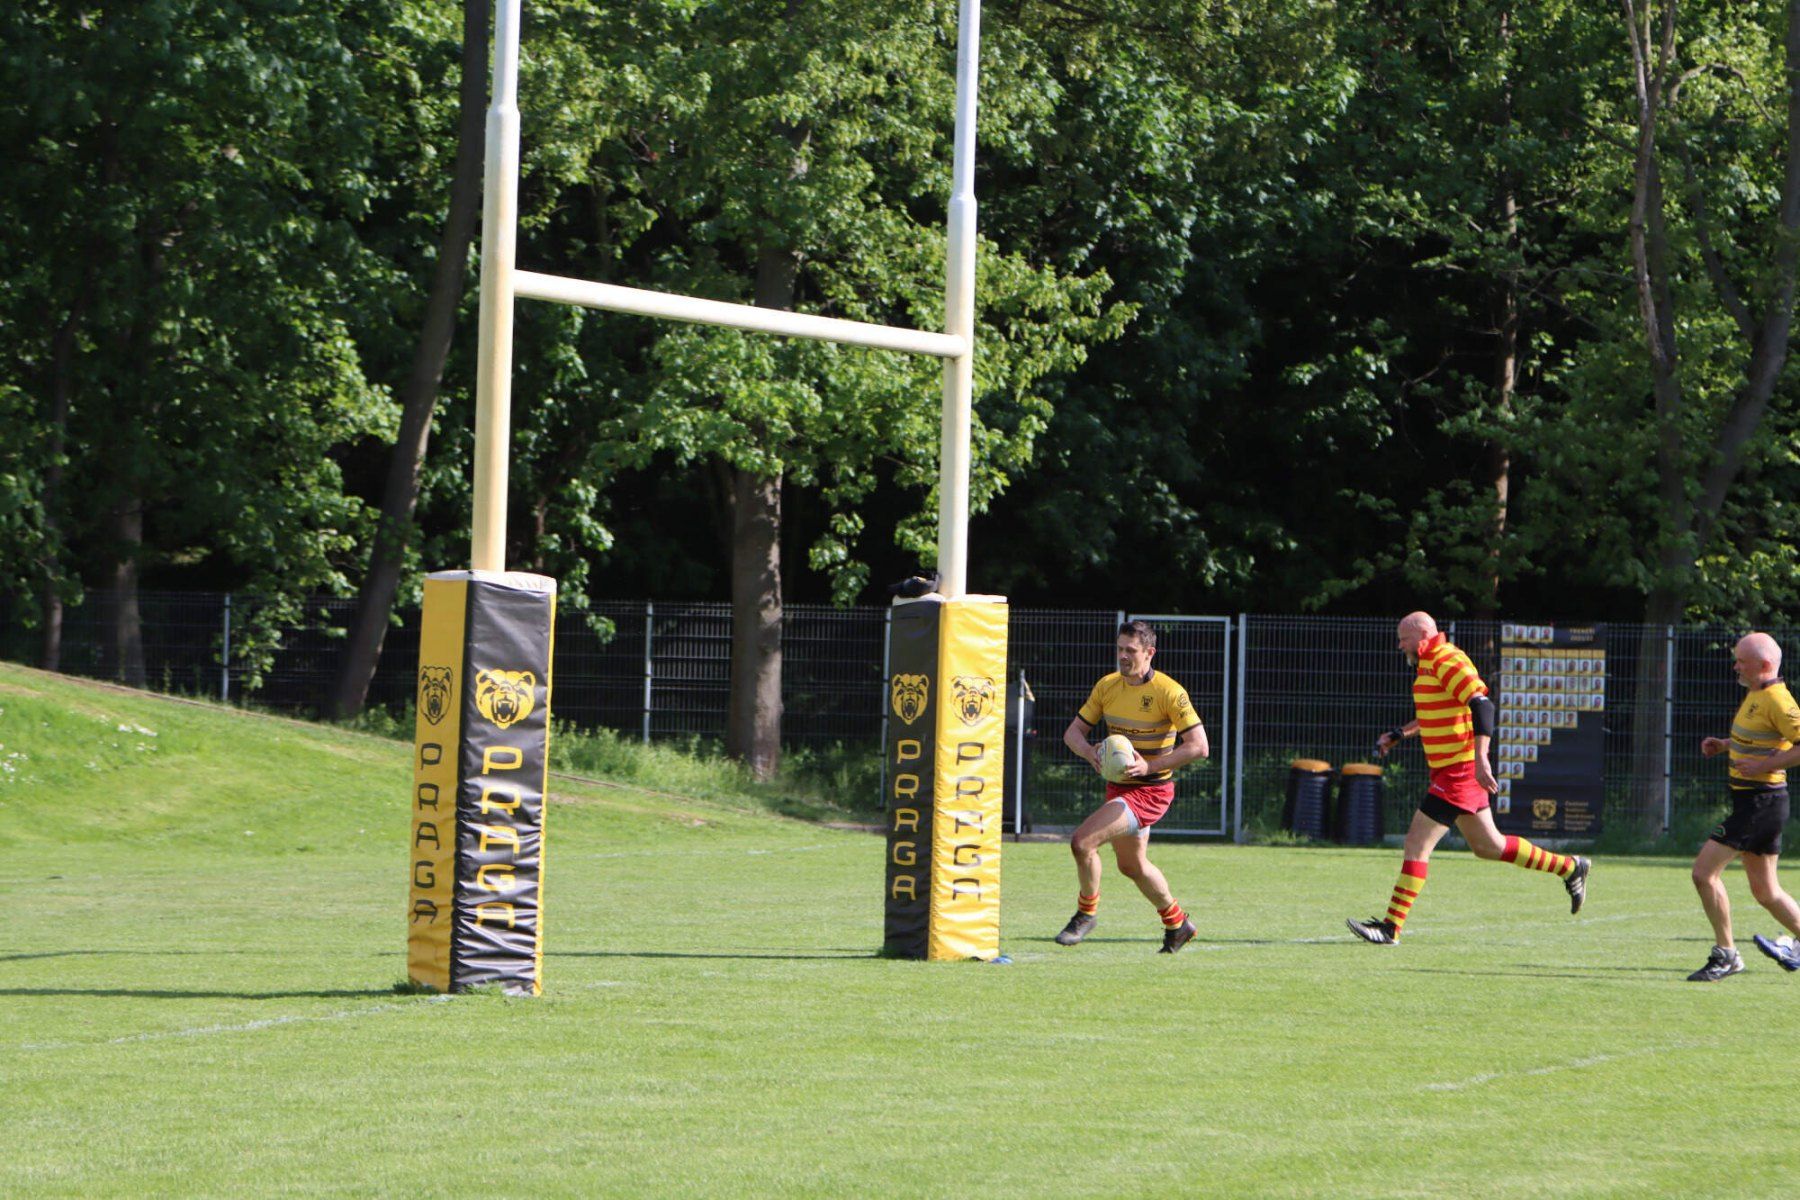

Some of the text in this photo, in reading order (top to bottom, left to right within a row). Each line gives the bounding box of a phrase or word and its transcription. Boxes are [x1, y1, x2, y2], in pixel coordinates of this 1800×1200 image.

[413, 743, 443, 924] PRAGA
[476, 746, 523, 928] PRAGA
[892, 739, 921, 900] PRAGA
[953, 742, 985, 901] PRAGA
